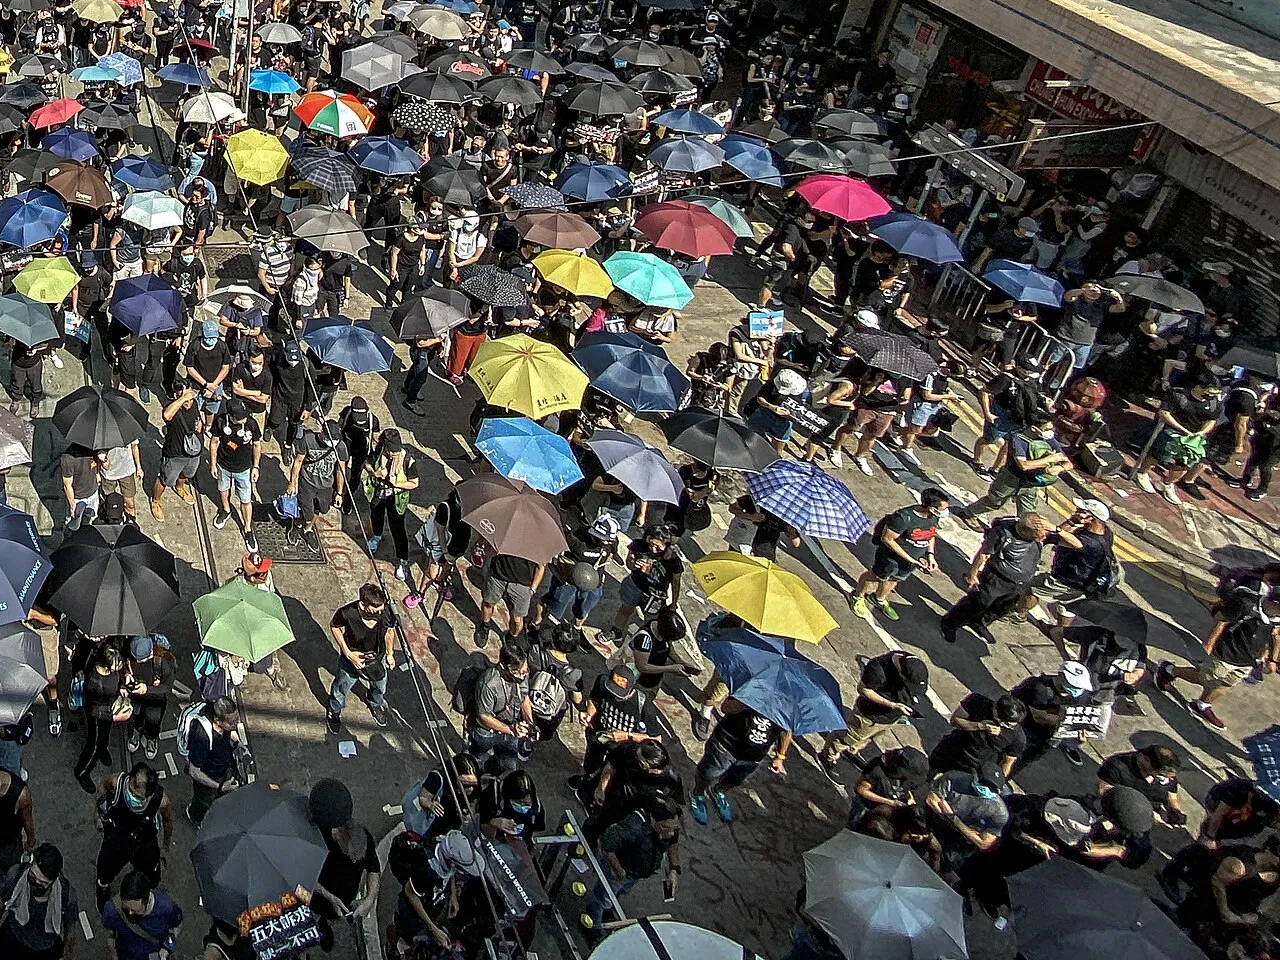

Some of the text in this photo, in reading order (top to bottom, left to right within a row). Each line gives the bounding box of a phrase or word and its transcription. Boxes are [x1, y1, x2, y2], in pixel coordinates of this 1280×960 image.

[781, 396, 829, 427] 五大訴求
[18, 558, 43, 602] MAINTENANCE
[485, 840, 533, 908] THANK YOU WORLD
[250, 904, 311, 944] 五大訴求
[258, 926, 320, 960] 缺一不可
